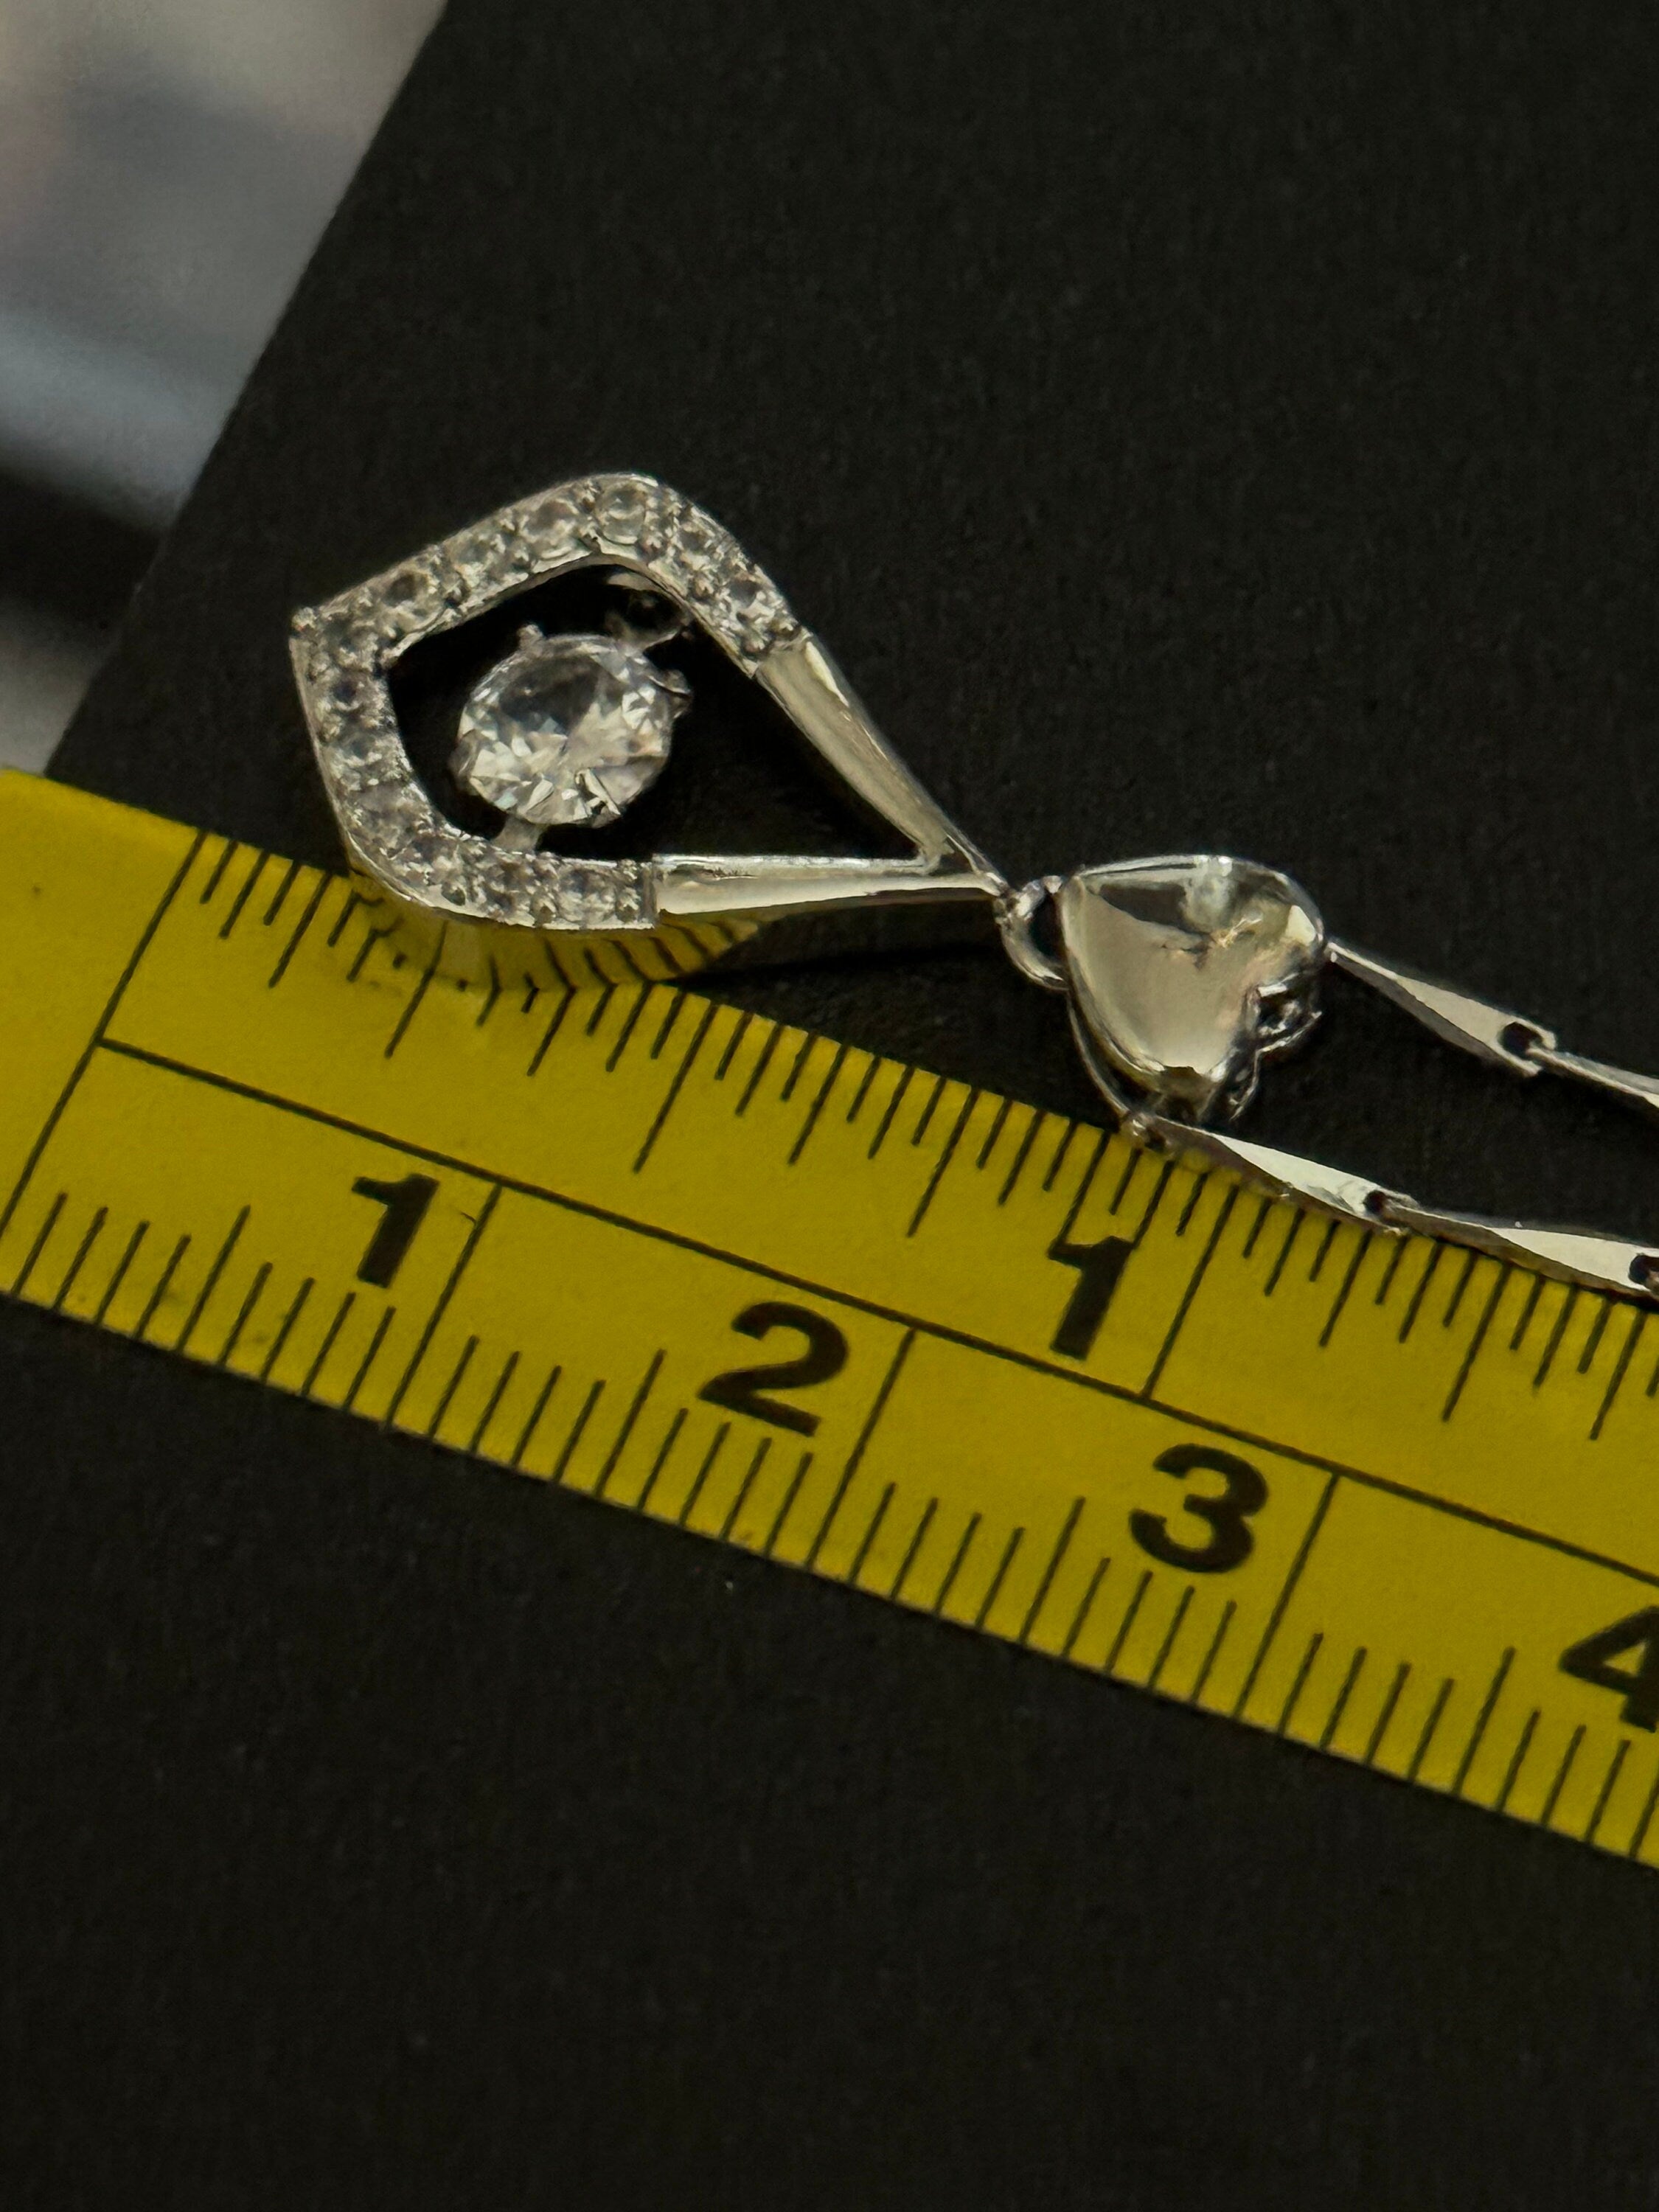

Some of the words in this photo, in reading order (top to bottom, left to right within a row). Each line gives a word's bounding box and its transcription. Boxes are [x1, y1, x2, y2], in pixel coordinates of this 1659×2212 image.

[352, 1174, 439, 1288] 1
[1047, 1236, 1135, 1360] 1
[697, 1301, 849, 1437] 2
[1128, 1443, 1268, 1574] 3
[1559, 1605, 1659, 1733] 4
